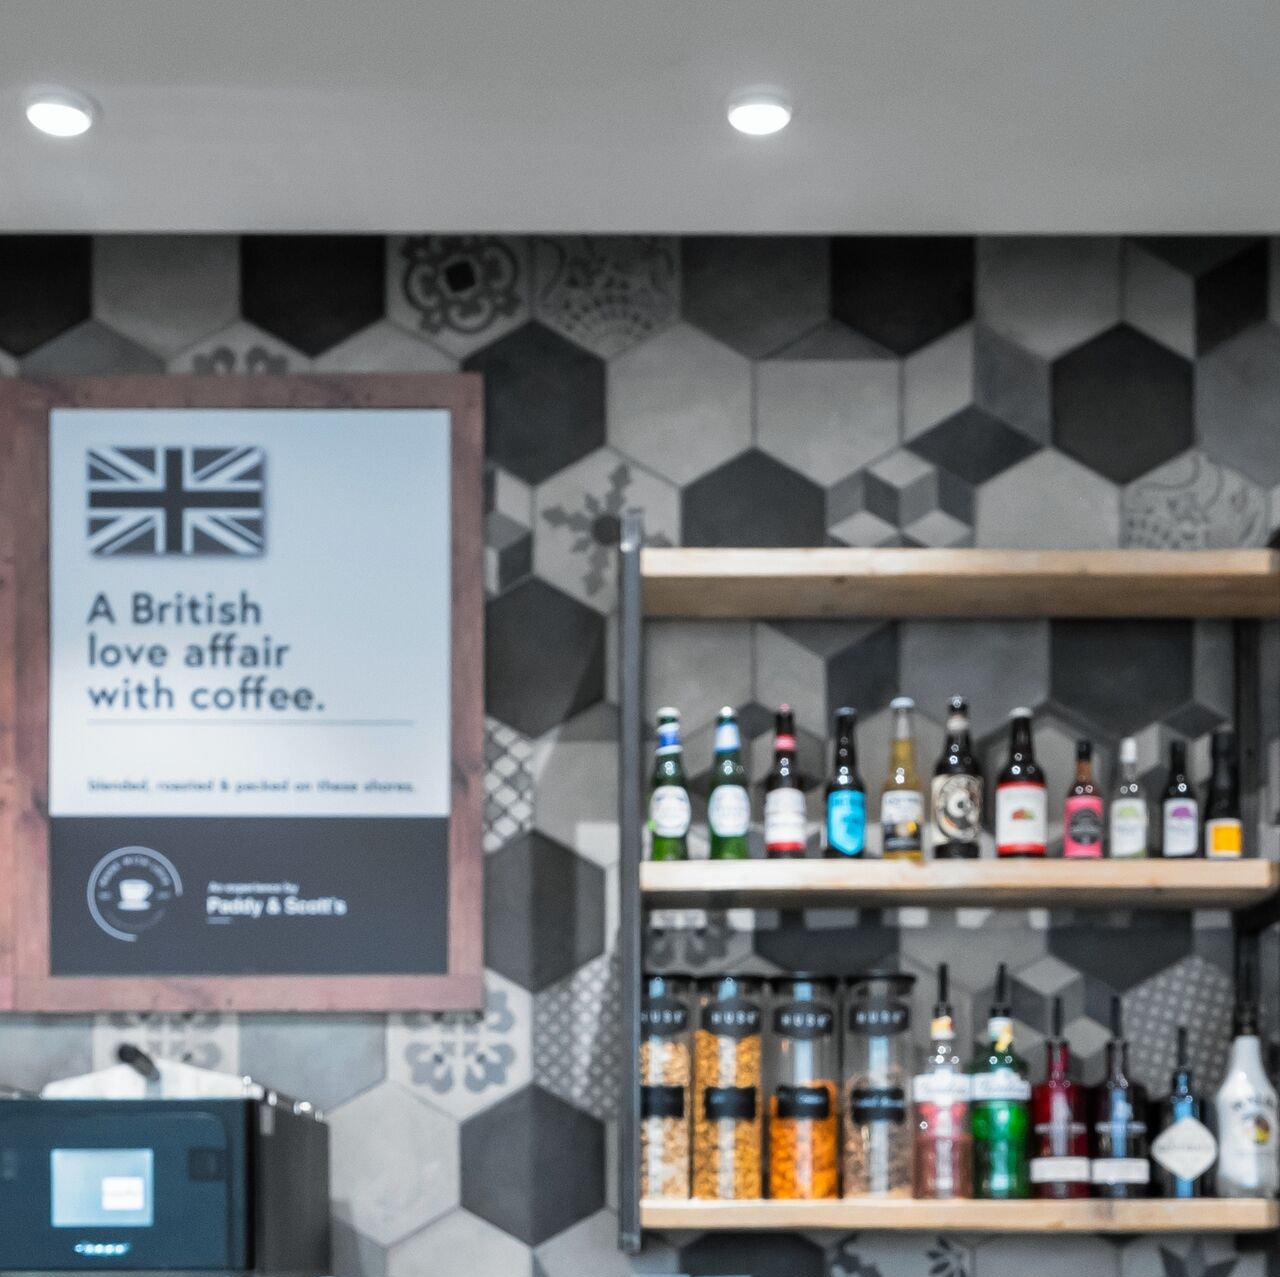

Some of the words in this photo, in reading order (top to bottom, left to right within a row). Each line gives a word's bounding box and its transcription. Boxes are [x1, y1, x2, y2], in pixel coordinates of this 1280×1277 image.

[87, 593, 116, 625] A
[132, 591, 262, 626] British
[87, 633, 169, 668] love
[183, 633, 290, 668] affair
[87, 677, 175, 711] with
[190, 676, 326, 711] coffee.
[206, 896, 262, 919] Paddy
[266, 897, 281, 916] &
